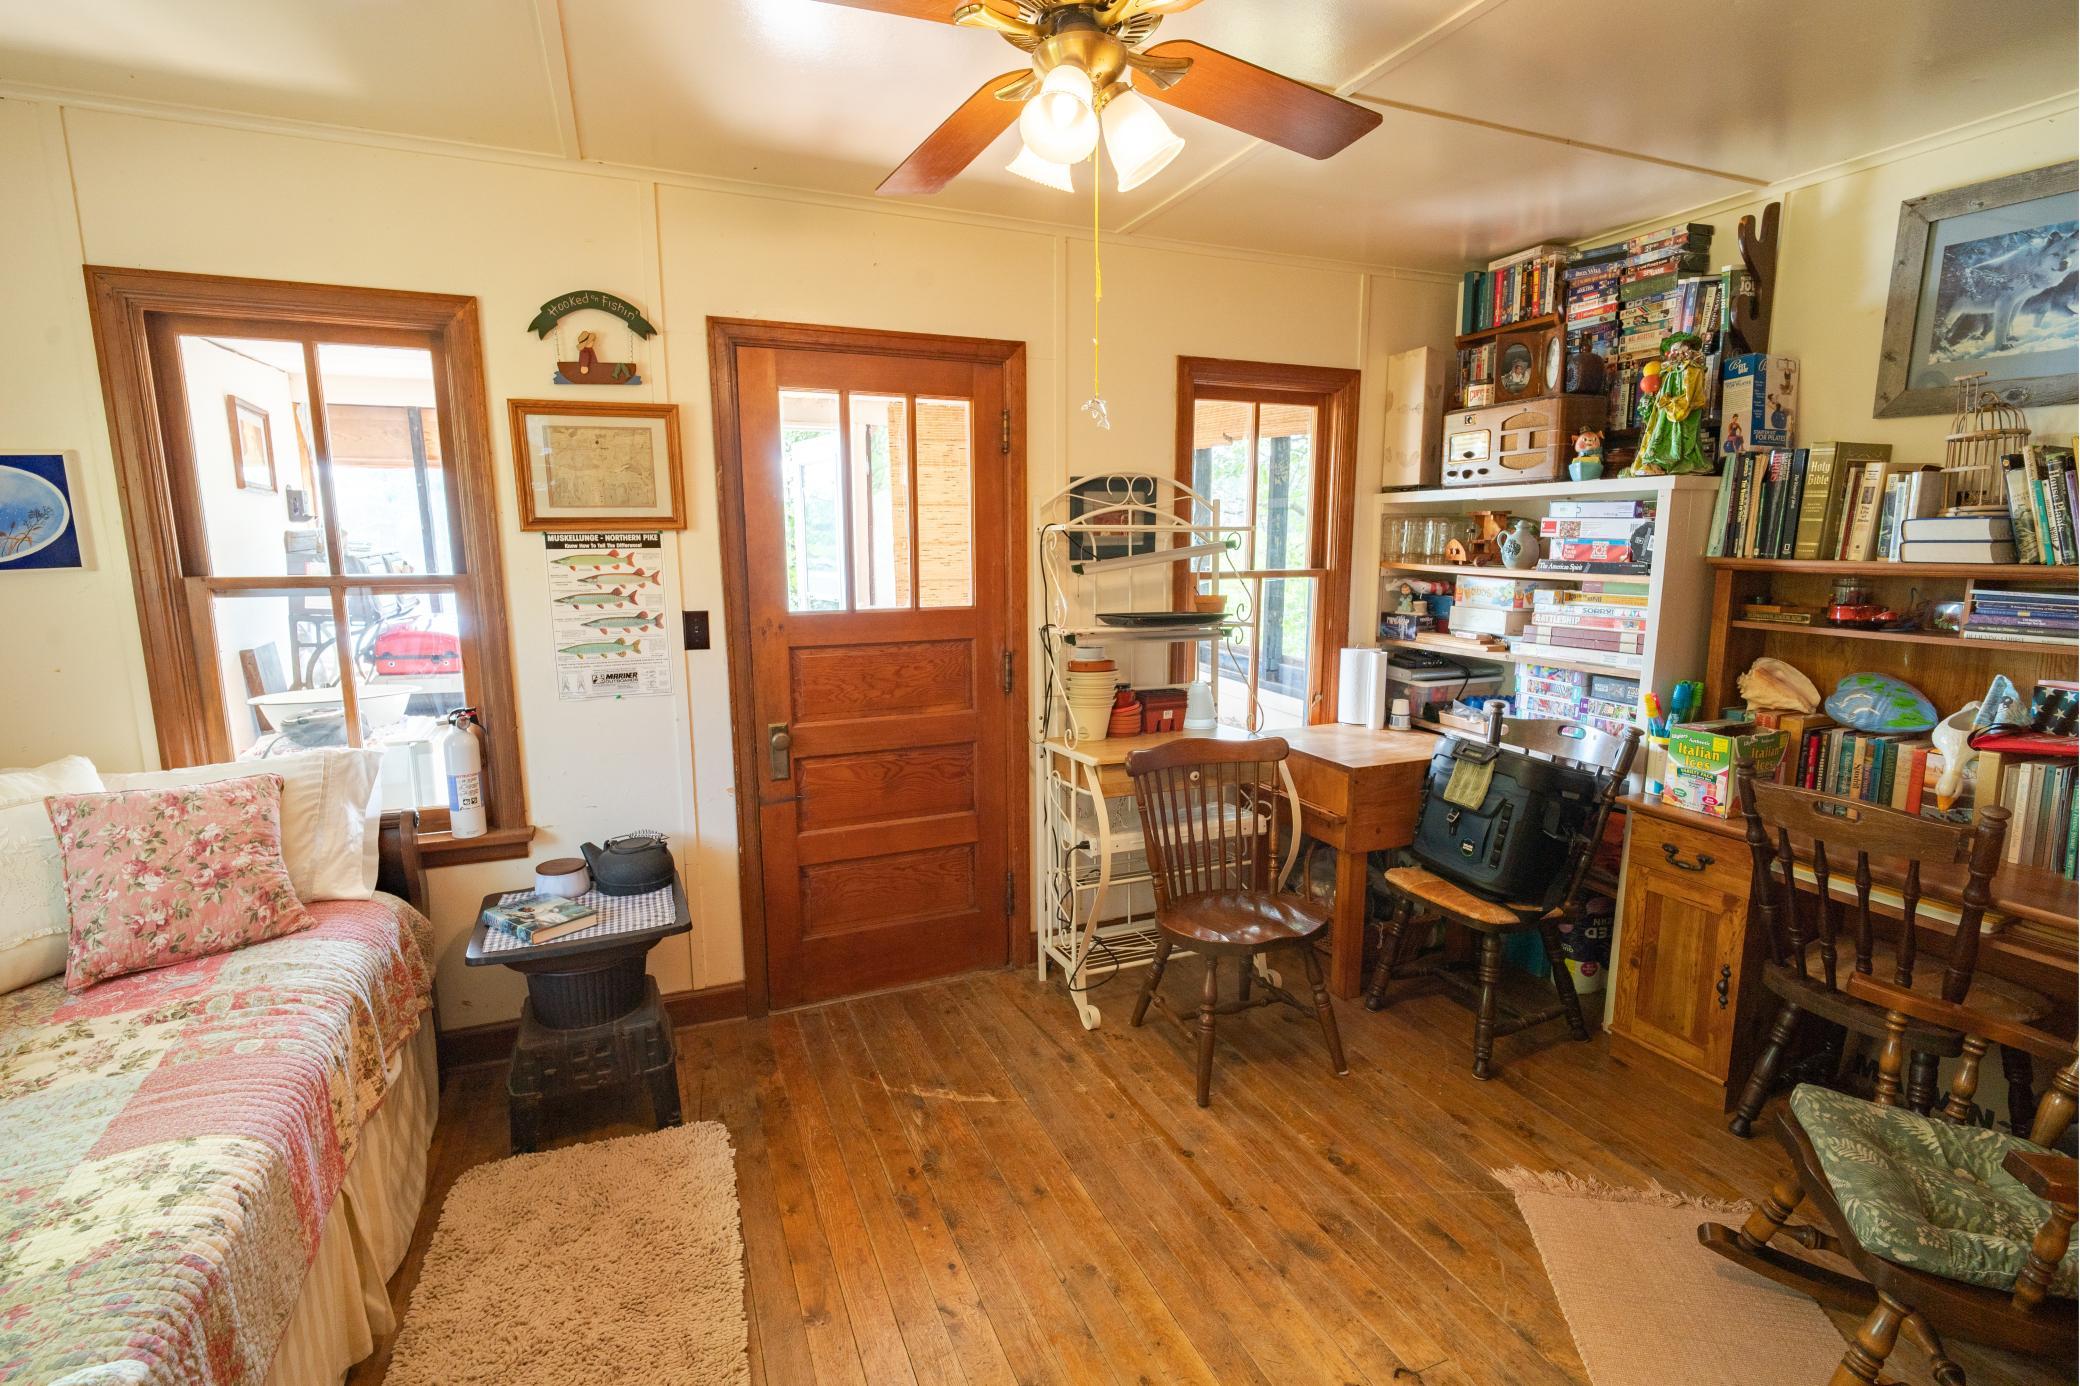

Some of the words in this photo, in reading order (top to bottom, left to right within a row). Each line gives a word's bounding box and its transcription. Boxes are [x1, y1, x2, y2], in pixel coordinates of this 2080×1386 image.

[548, 292, 588, 318] Hooked
[590, 294, 599, 302] on
[602, 296, 639, 320] Fishin'
[1811, 460, 1830, 474] Holy
[1808, 474, 1830, 485] Bible
[2048, 470, 2060, 498] House
[2053, 502, 2066, 532] Plants
[548, 534, 599, 542] MUSKELLUNGE
[605, 534, 642, 542] NORTHERN
[1570, 564, 1583, 572] Spirit
[1534, 615, 1580, 625] BATTLESHIP
[1678, 743, 1720, 761] Italian
[1752, 746, 1779, 759] Italian
[1684, 756, 1710, 770] Ices
